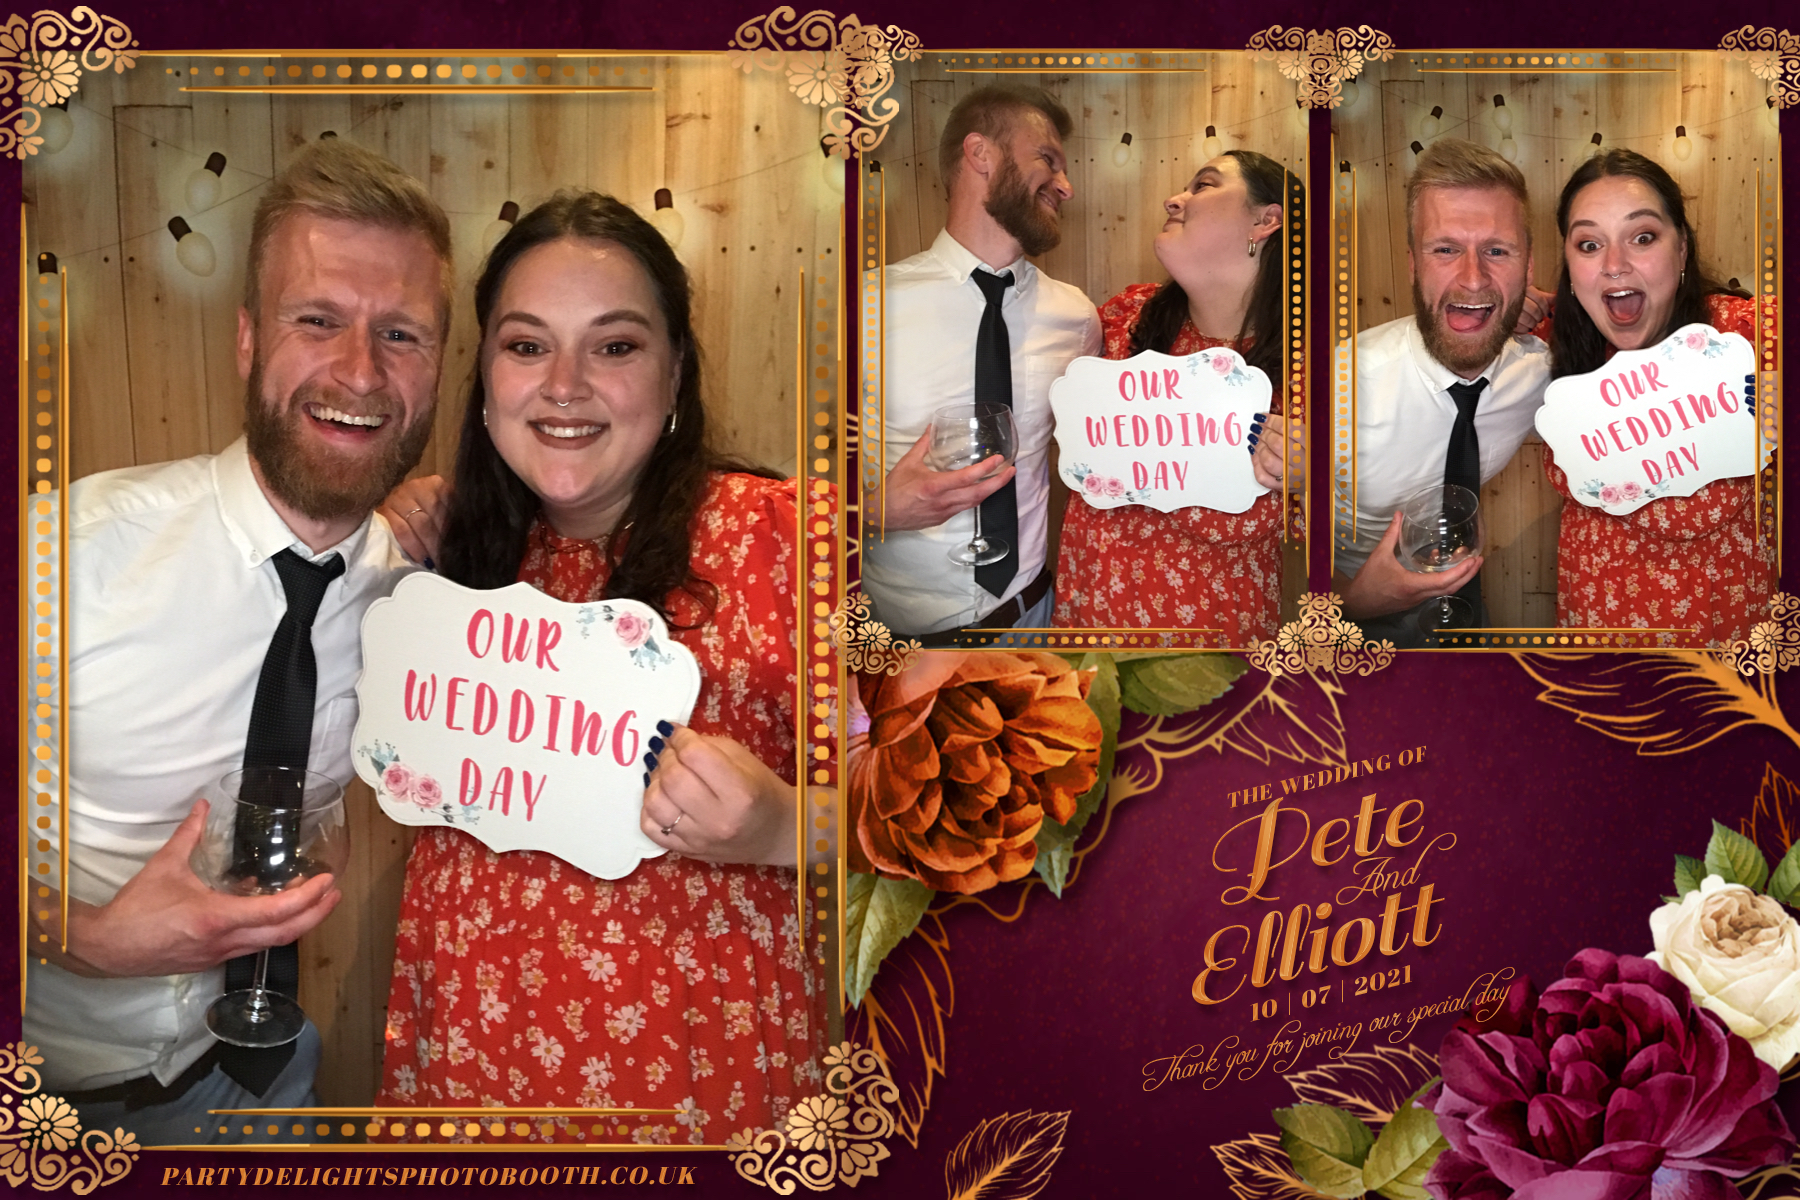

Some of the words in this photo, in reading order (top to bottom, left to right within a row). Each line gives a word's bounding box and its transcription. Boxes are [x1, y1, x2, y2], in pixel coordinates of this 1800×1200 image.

[1118, 369, 1183, 402] OUR
[1599, 361, 1669, 407] OUR
[1085, 411, 1242, 448] WEDDING
[1580, 381, 1739, 462] WEDDING
[1132, 460, 1189, 491] DAY
[1641, 442, 1700, 486] DAY
[466, 608, 562, 672] OUR
[404, 669, 640, 767] WEDDING
[458, 757, 547, 822] DAY
